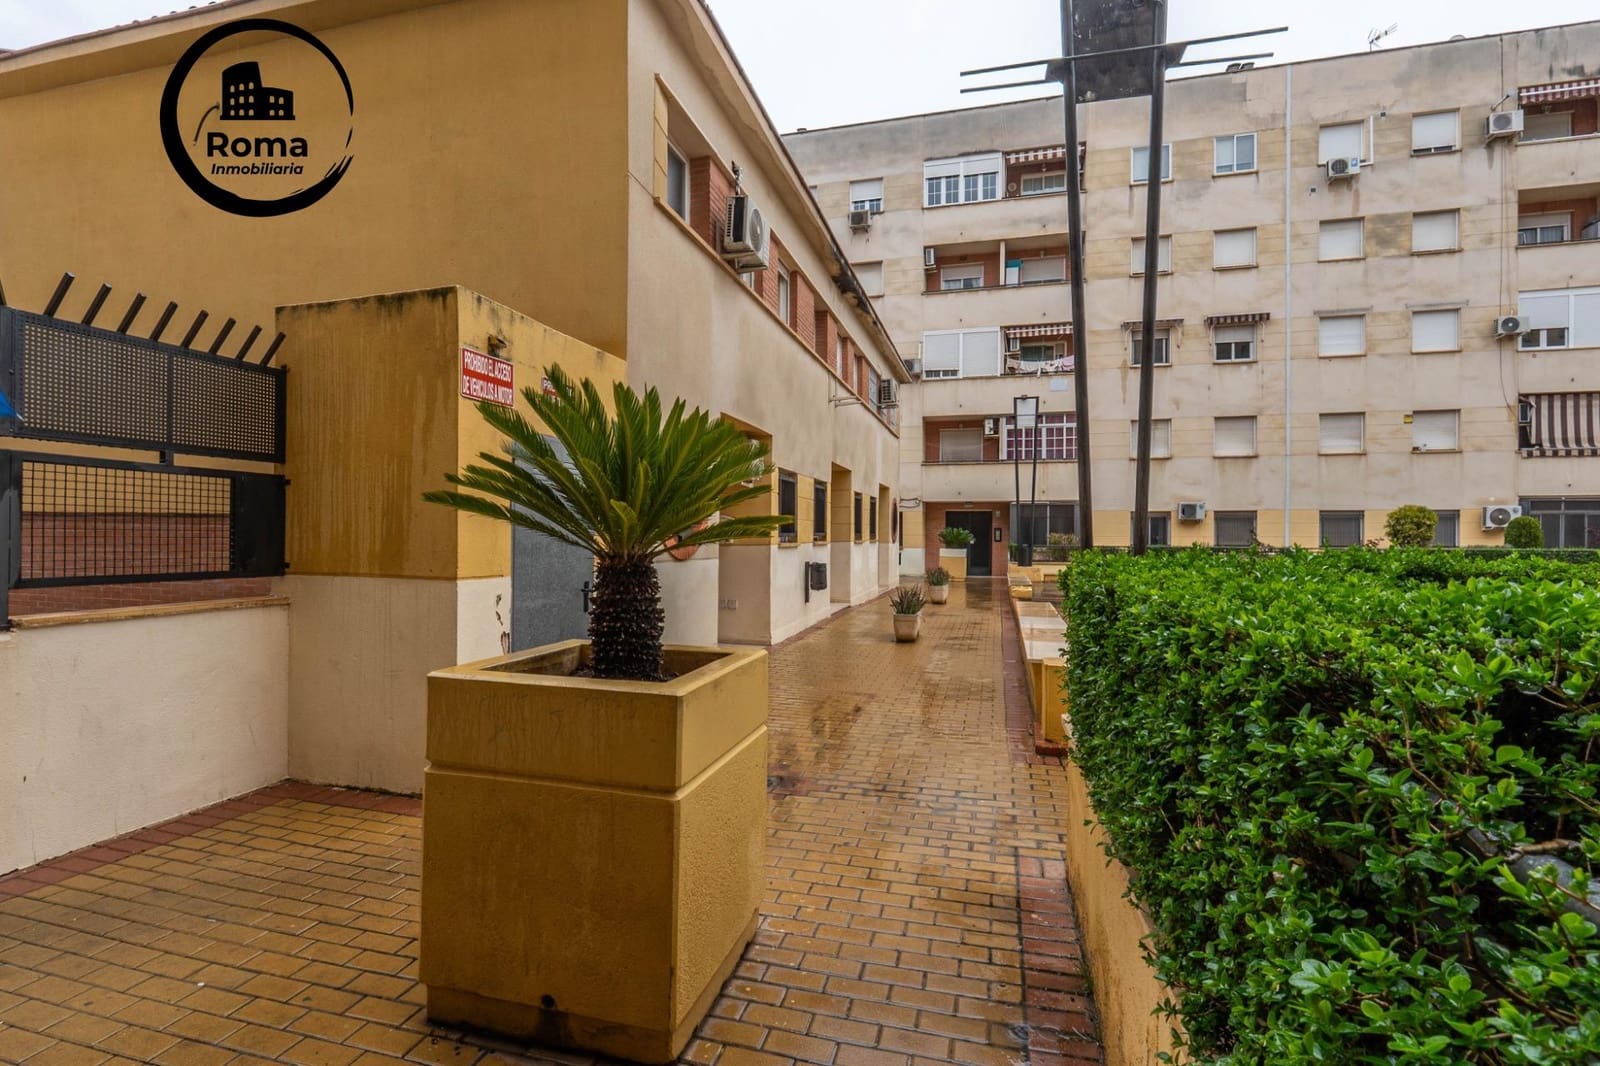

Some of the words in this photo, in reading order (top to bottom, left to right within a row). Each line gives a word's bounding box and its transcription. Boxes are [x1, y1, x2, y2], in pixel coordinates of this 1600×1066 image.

[464, 350, 488, 375] PROHIBIDO
[488, 359, 494, 377] EL
[494, 361, 511, 382] ACCESO
[463, 375, 470, 394] DE
